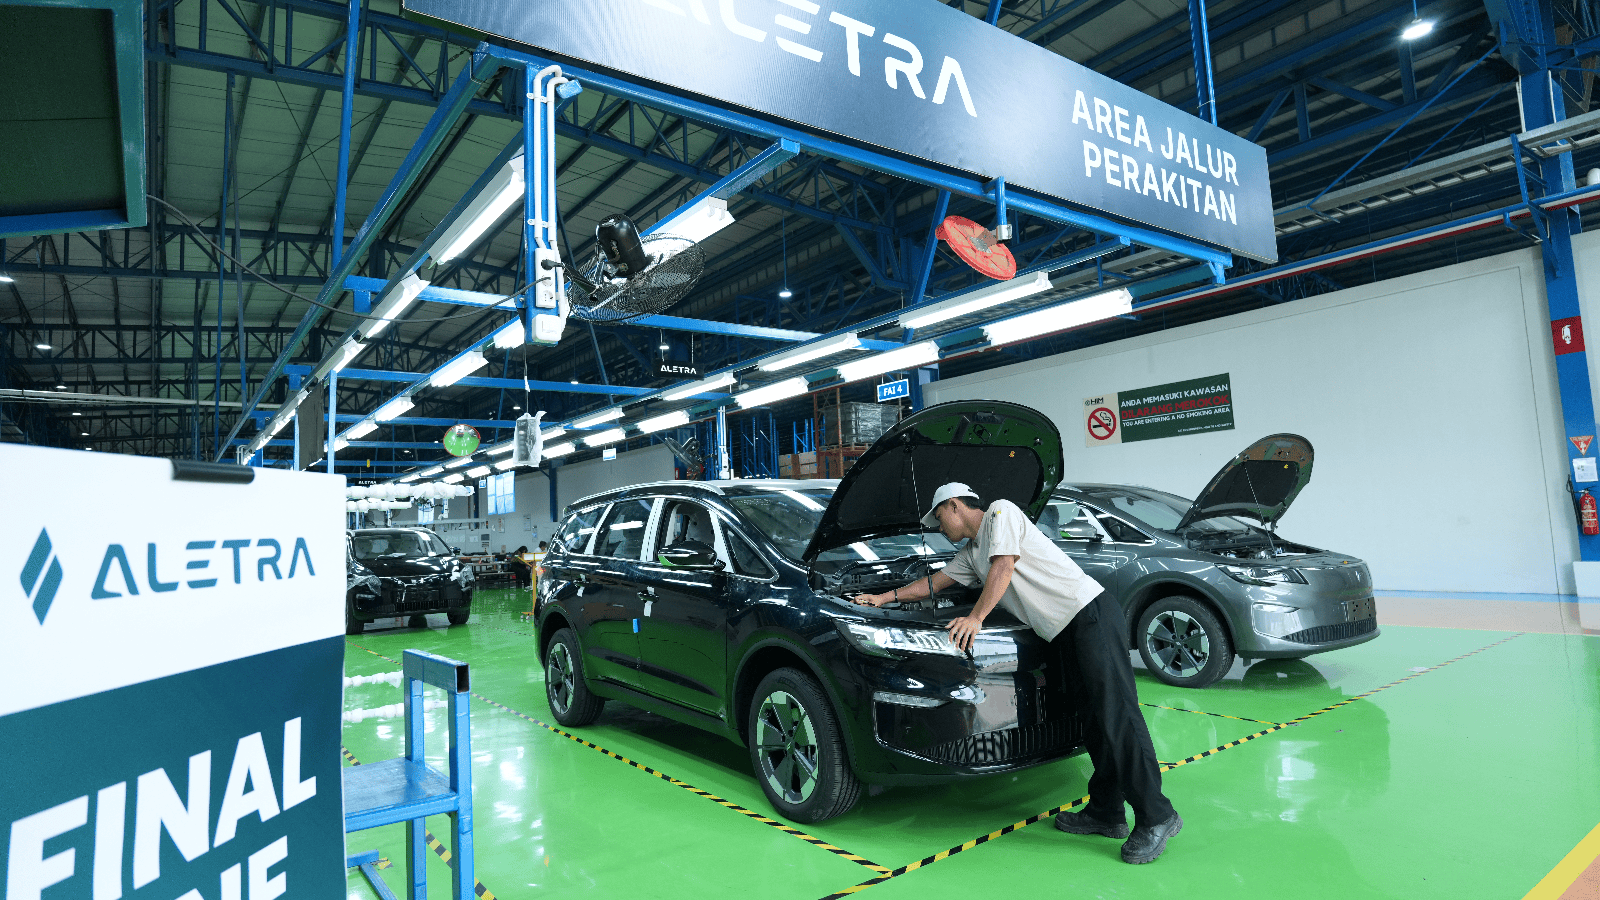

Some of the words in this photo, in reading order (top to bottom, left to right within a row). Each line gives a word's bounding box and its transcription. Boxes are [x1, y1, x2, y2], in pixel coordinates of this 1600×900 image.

[1071, 89, 1154, 153] AREA
[1160, 126, 1239, 187] JALUR
[1082, 139, 1238, 226] PERAKITAN
[661, 365, 697, 375] ALETRA
[896, 384, 903, 394] 4
[1143, 392, 1182, 404] MEMASUKI
[1184, 384, 1228, 397] KAWASAN
[1122, 404, 1173, 419] DILARANG
[1175, 395, 1230, 411] MEROKOK
[1186, 410, 1212, 418] SMOKING
[91, 537, 316, 600] ALETRA
[5, 716, 317, 900] FINAL
